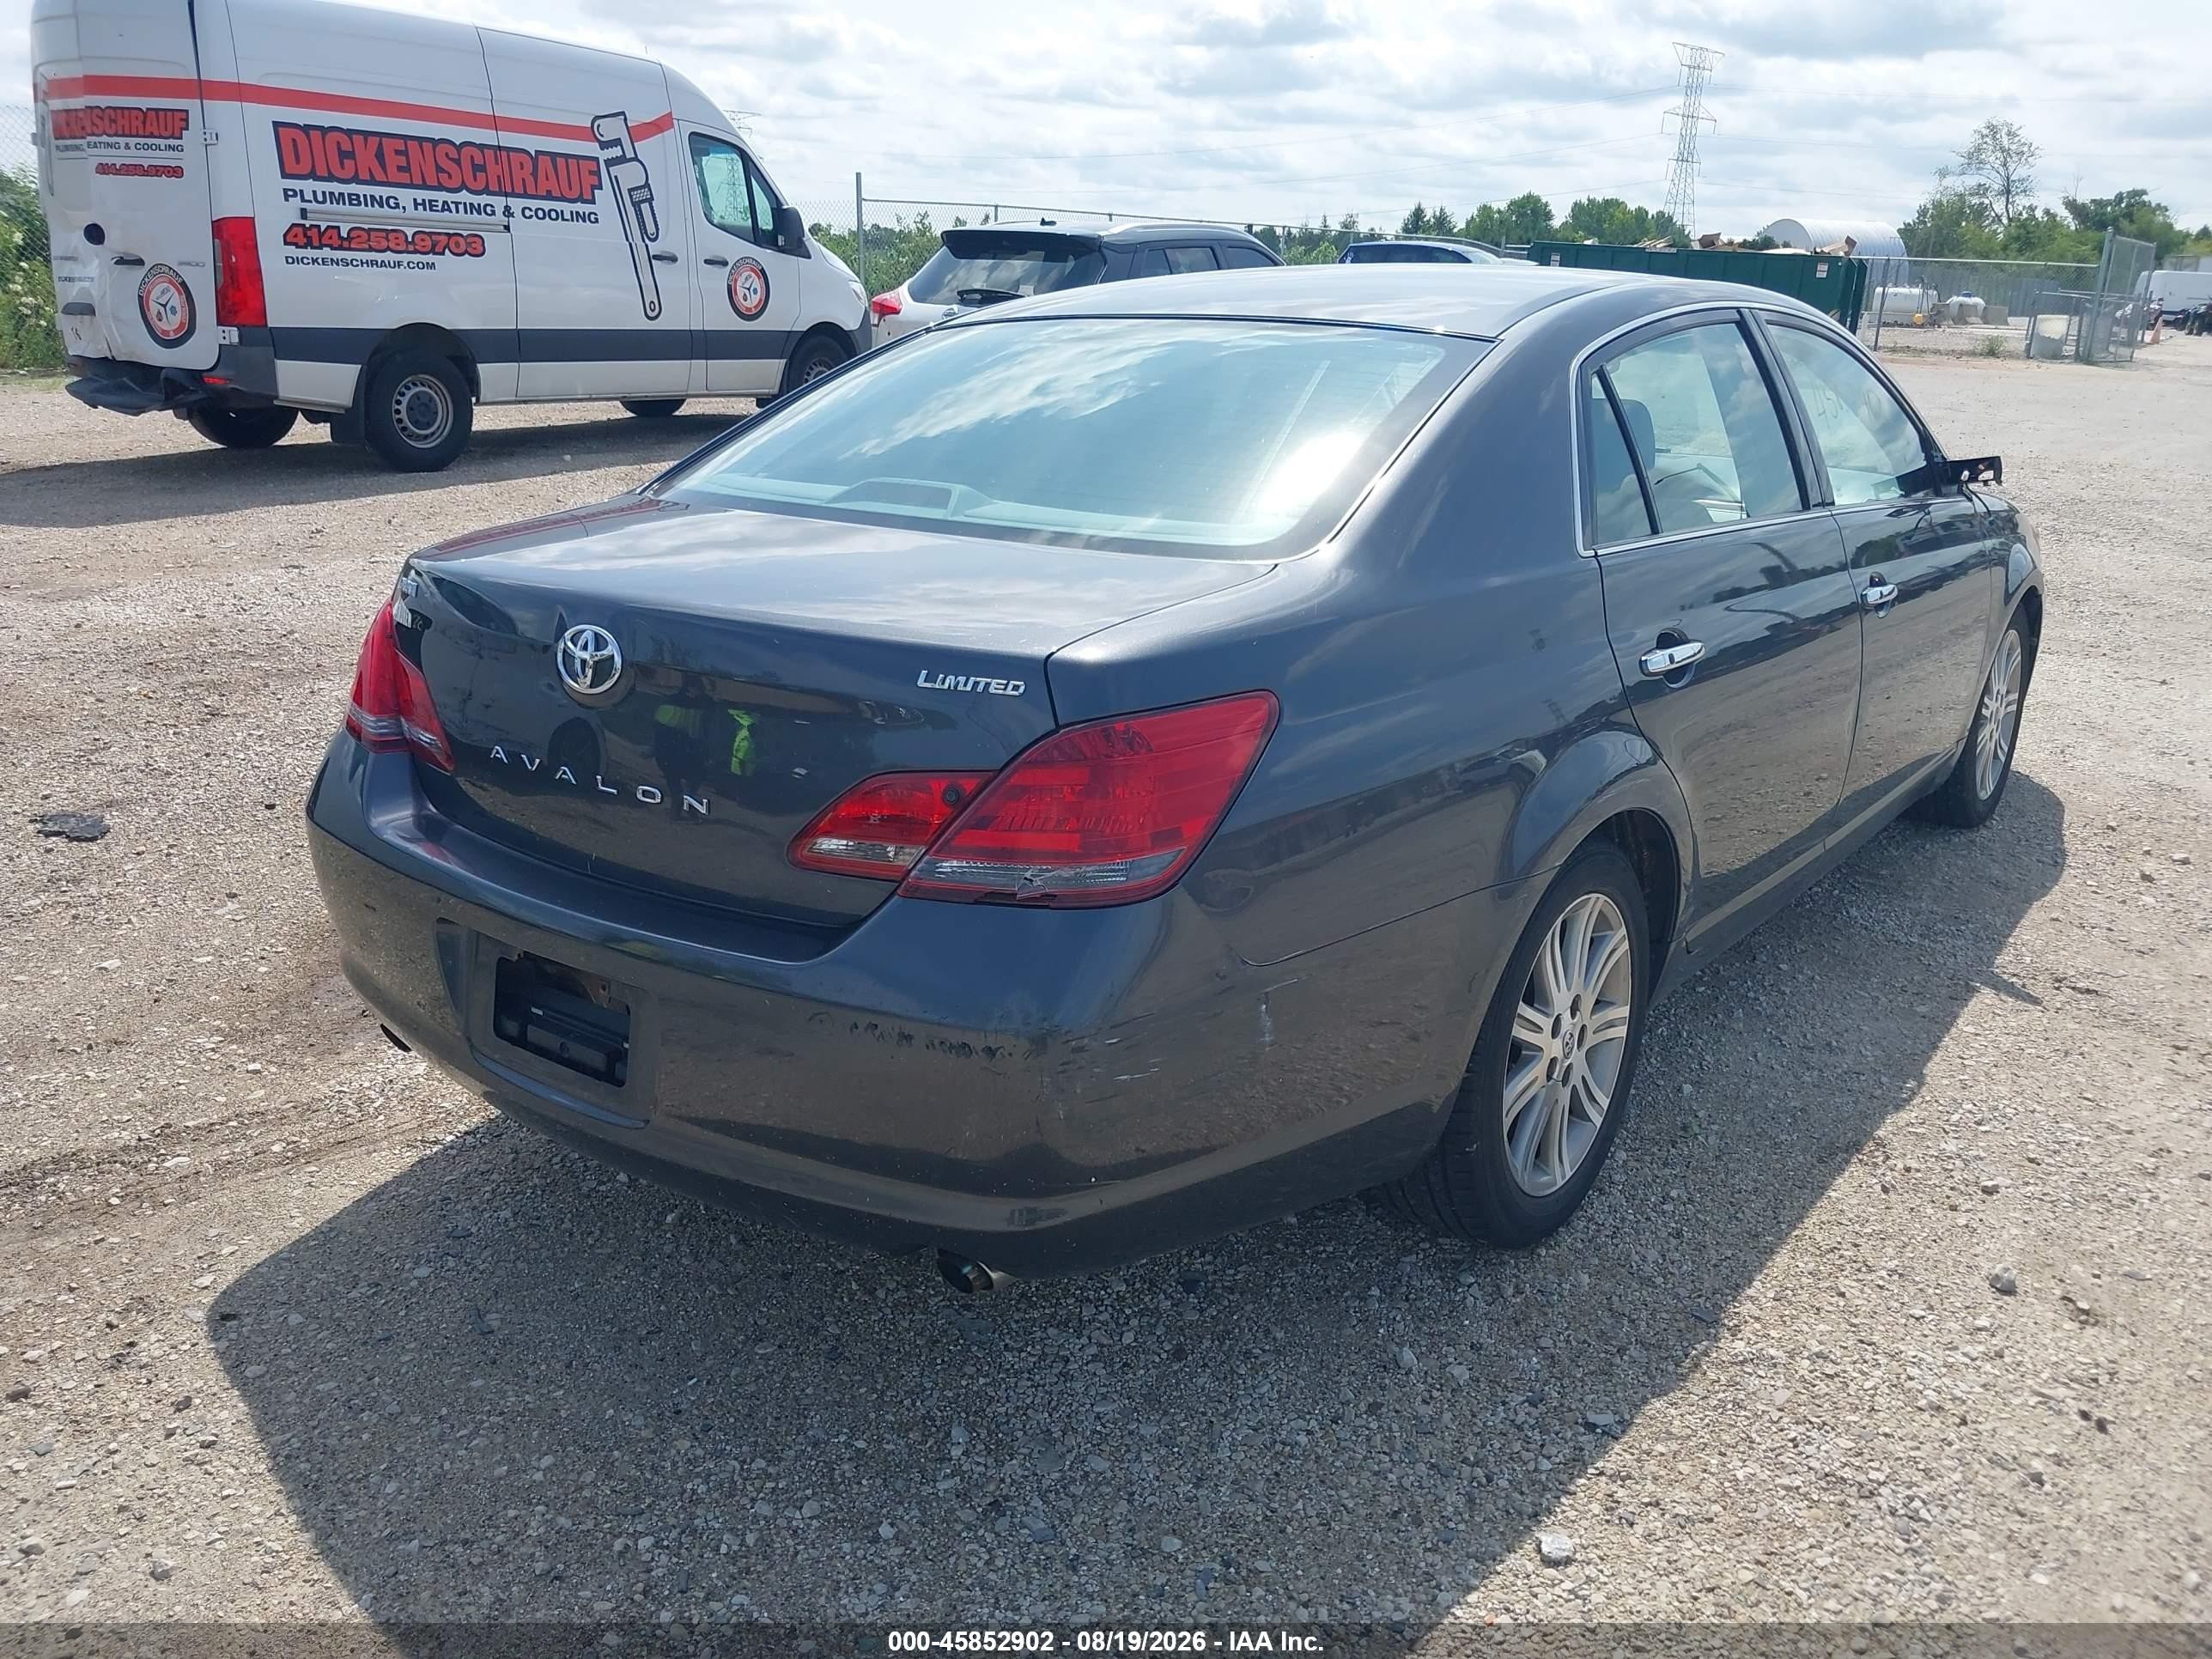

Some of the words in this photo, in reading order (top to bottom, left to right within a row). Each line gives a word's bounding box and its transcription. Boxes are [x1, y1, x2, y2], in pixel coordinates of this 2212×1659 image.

[135, 143, 184, 152] COOLING
[96, 163, 184, 179] 414.258.9703
[274, 124, 601, 203] DICKENSCHRAUF
[283, 187, 407, 213] PLUMBING,
[413, 198, 496, 217] HEATING
[502, 204, 515, 218] &
[521, 206, 599, 224] COOLING
[284, 224, 486, 257] 414.258.9703
[284, 255, 436, 270] DICKENSCHRAUF.COM
[916, 670, 1026, 696] LIMITED
[490, 745, 708, 816] AVALON
